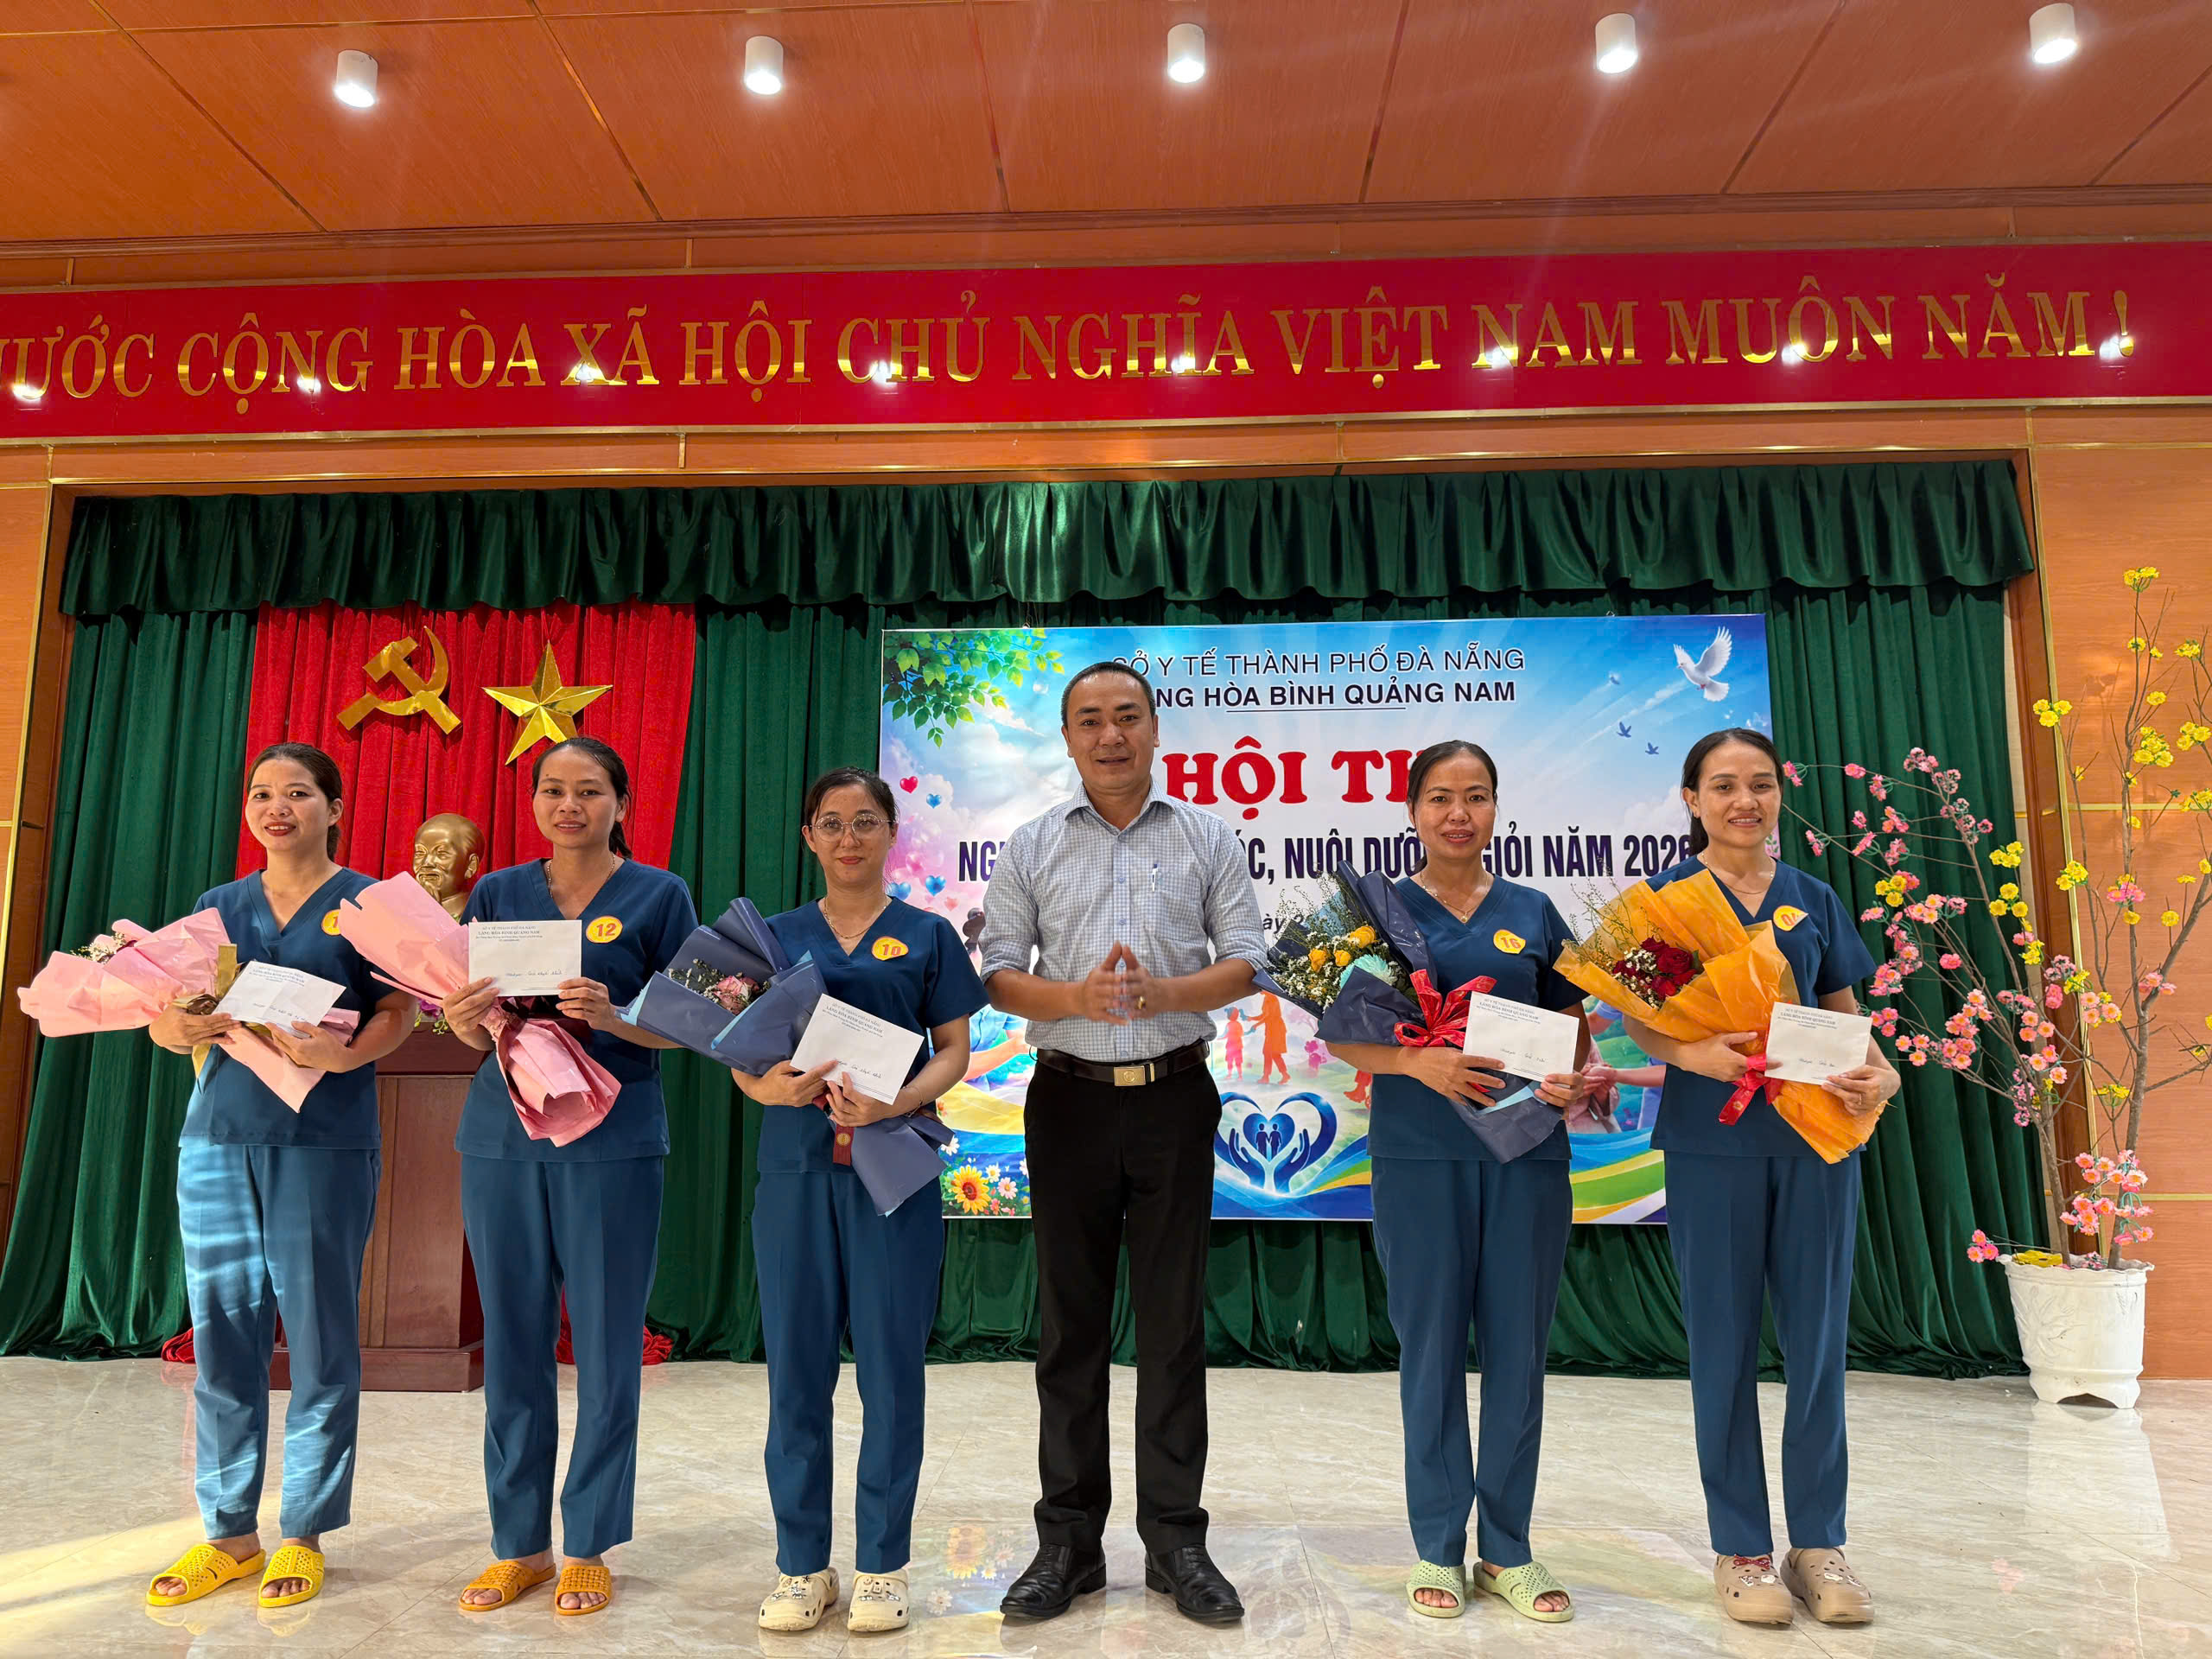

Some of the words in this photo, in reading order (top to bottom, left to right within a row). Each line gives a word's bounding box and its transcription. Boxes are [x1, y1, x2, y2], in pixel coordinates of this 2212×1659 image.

[0, 314, 155, 400] ƯỚC
[178, 312, 373, 415] CỘNG
[394, 307, 546, 388] HÒA
[561, 304, 660, 385] XÃ
[679, 300, 813, 403] HỘI
[837, 289, 987, 384] CHỦ
[1012, 293, 1255, 381] NGHĨA
[1270, 285, 1449, 388] VIỆT
[1471, 301, 1643, 369] NAM
[1661, 275, 1895, 365] MUÔN
[1157, 656, 1173, 677] Y
[1182, 647, 1217, 677] TẾ
[1224, 649, 1319, 676] THÀNH
[1330, 645, 1389, 673] PHỐ
[1396, 646, 1434, 671] ĐÀ
[1444, 642, 1524, 671] NẴNG
[1205, 682, 1261, 707] HÒA
[1270, 681, 1334, 706] BÌNH
[1344, 676, 1444, 705] QUẢNG
[1454, 681, 1515, 703] NAM
[1161, 735, 1308, 820] HỘI
[1284, 828, 1354, 879] NUÔI
[1543, 825, 1613, 878] NĂM
[596, 922, 617, 938] 12
[1500, 937, 1522, 950] 16
[881, 944, 902, 956] 10
